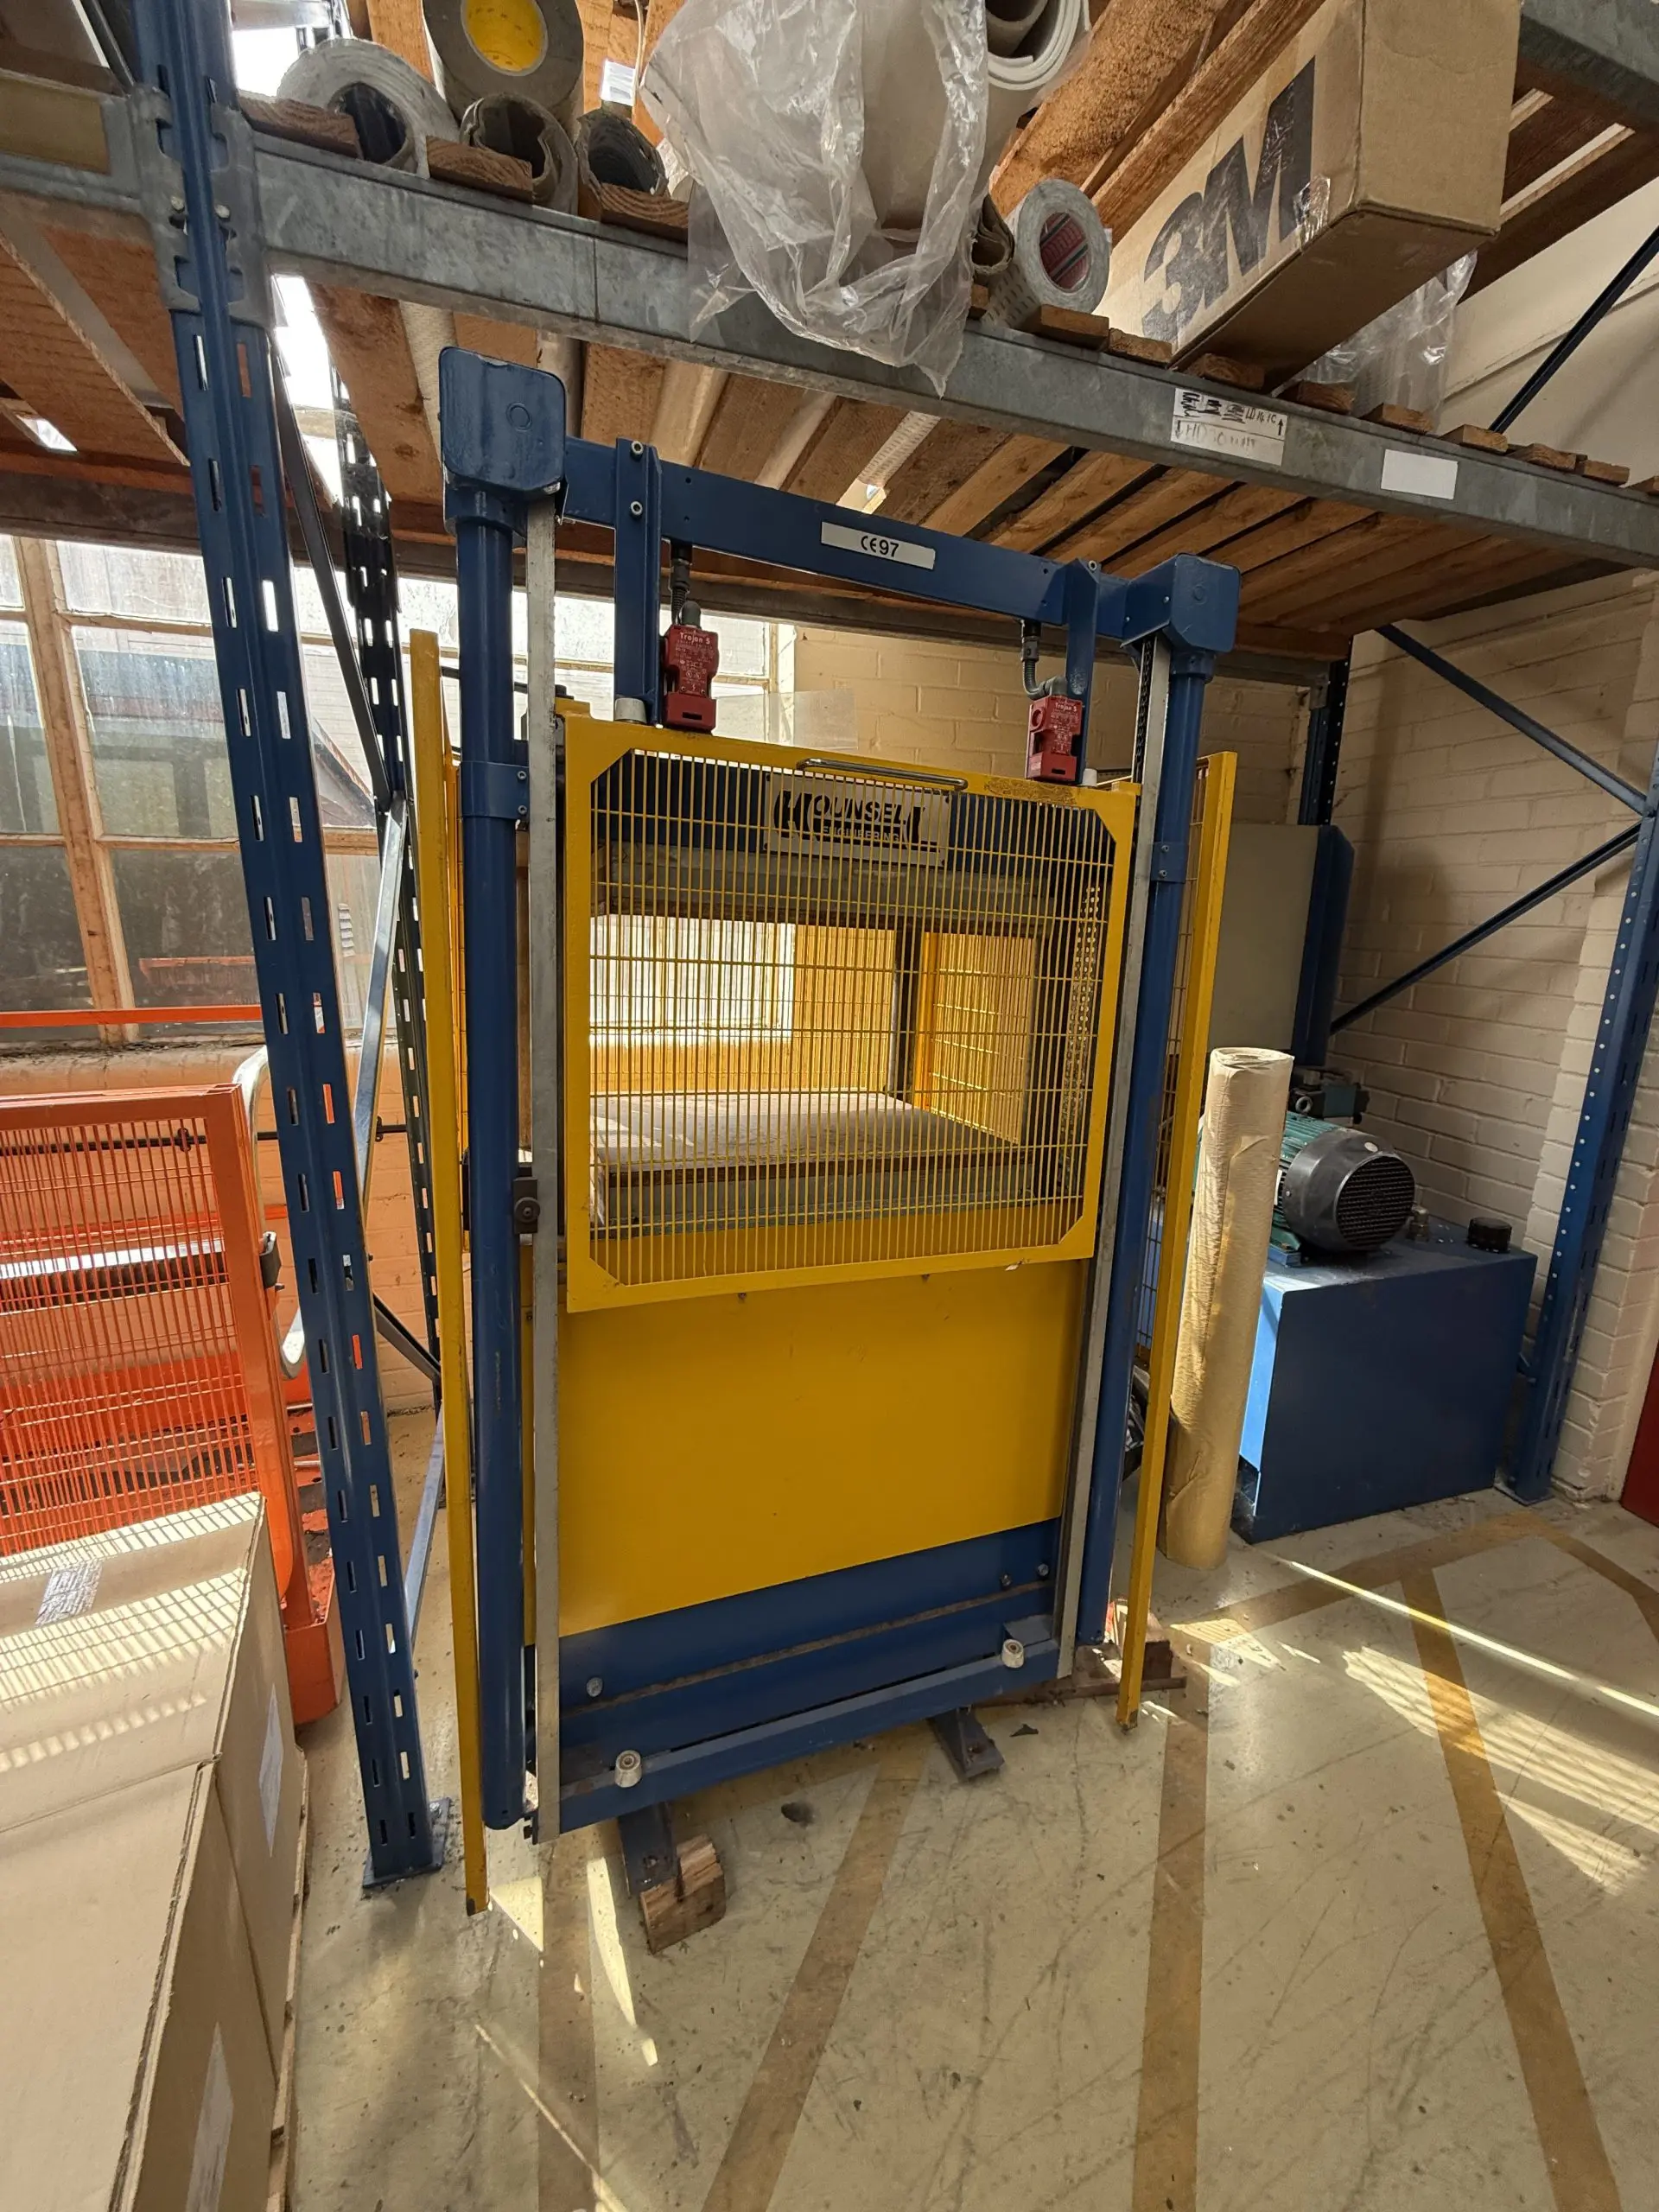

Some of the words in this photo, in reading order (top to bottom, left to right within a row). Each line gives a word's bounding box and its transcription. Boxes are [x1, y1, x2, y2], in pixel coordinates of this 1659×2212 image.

[1141, 54, 1316, 341] 3M
[679, 632, 703, 645] Trojan
[1054, 702, 1072, 712] Trojan
[822, 825, 900, 842] ENGINEERNG
